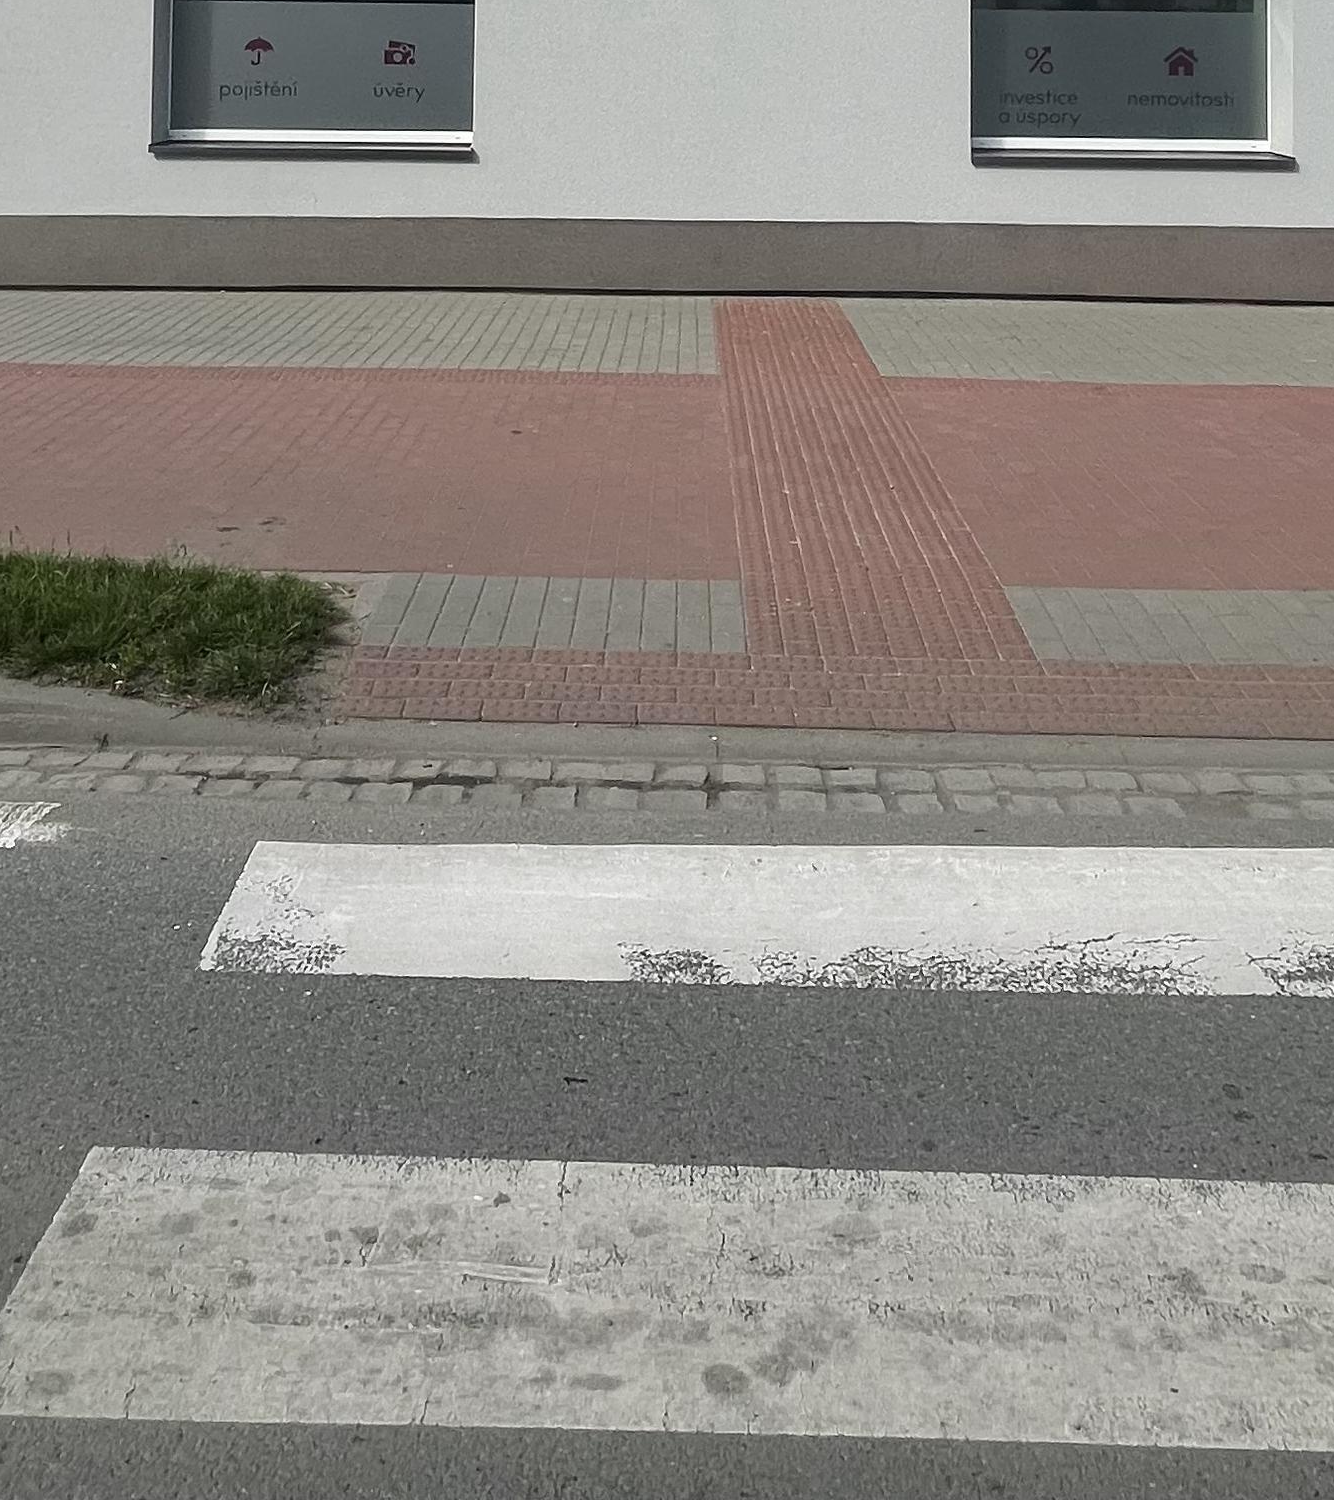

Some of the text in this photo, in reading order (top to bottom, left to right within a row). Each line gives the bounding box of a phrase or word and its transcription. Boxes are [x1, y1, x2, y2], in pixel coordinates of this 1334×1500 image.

[219, 80, 299, 101] pojištění
[373, 81, 426, 103] úvěry
[999, 89, 1078, 105] investice
[1126, 91, 1236, 108] nemovitosti
[998, 111, 1010, 124] a
